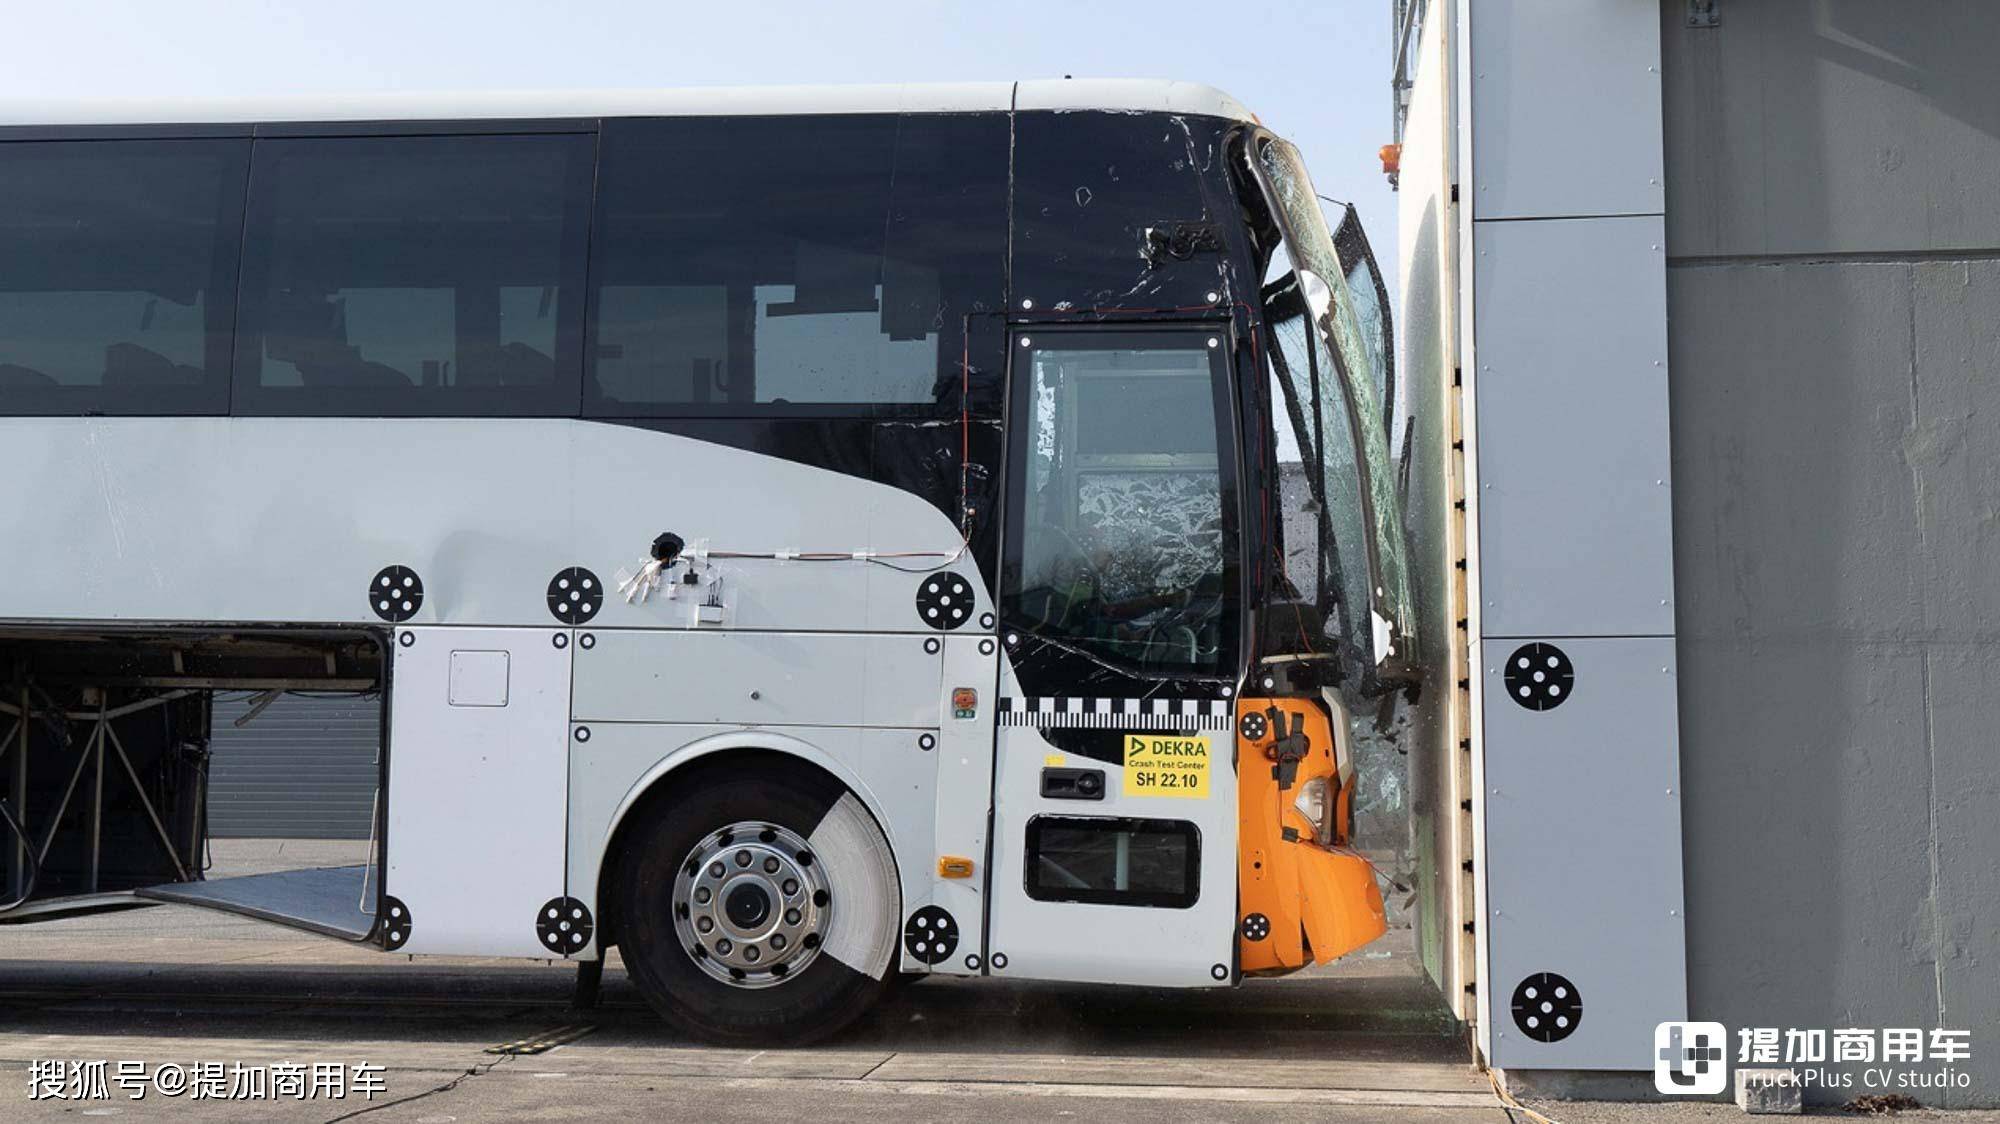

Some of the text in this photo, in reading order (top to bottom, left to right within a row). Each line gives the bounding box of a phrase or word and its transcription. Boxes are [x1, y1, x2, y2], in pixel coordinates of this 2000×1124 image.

[1152, 740, 1206, 756] DEKRA
[1129, 760, 1205, 770] Crash Test Center
[1136, 772, 1198, 788] SH 22.10
